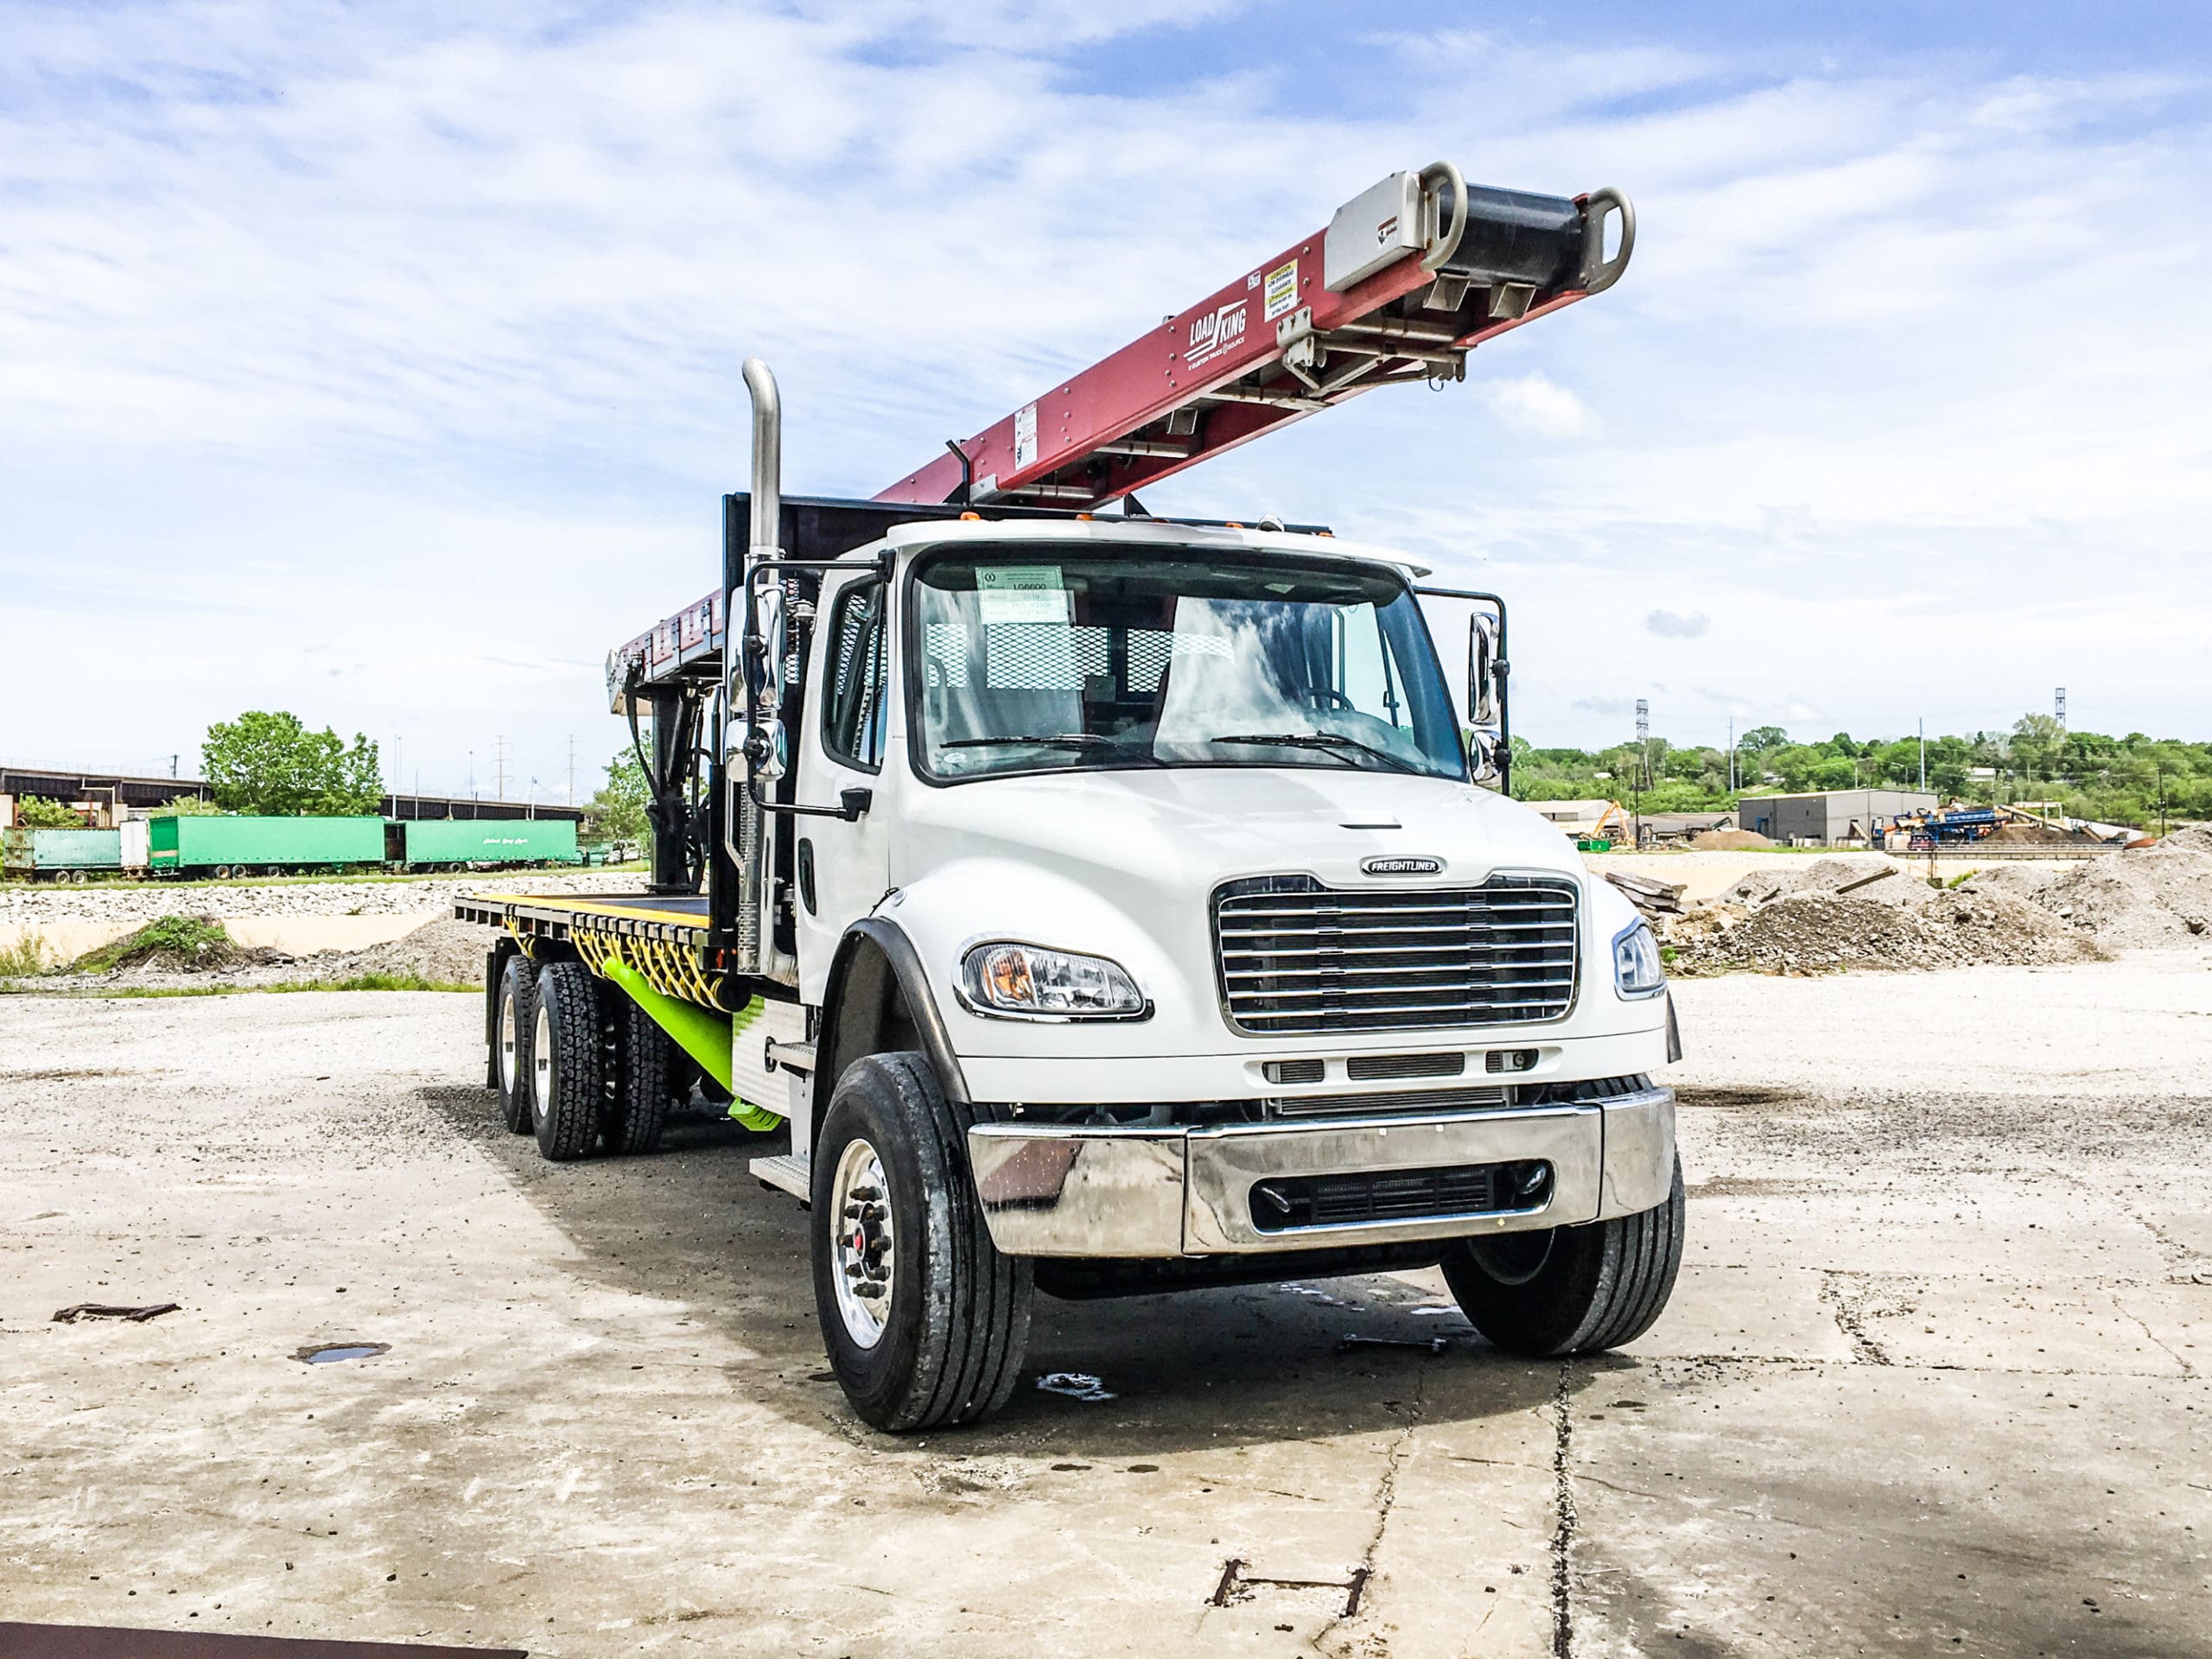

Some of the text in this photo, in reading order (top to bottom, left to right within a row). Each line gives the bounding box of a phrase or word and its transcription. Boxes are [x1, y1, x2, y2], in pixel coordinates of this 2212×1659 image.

[1190, 308, 1247, 346] LOAD KING
[1371, 861, 1436, 871] FREIGHTLINER
